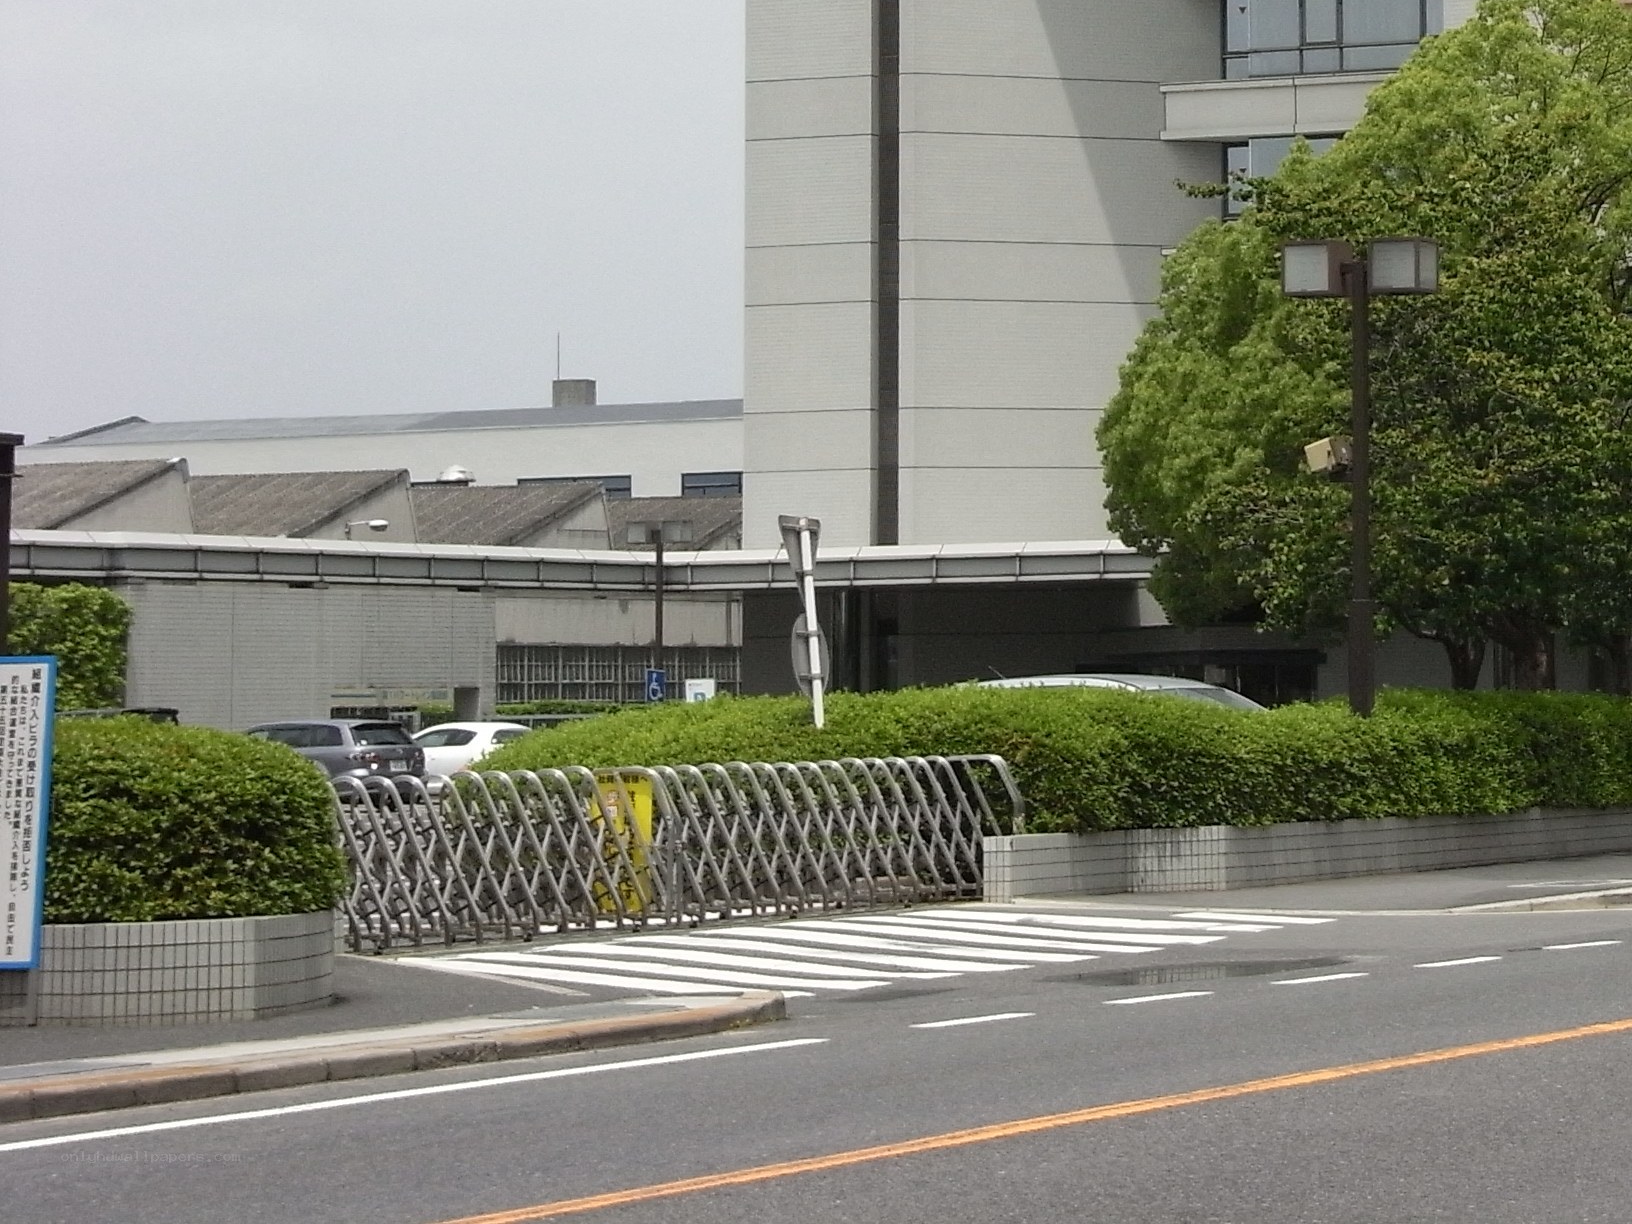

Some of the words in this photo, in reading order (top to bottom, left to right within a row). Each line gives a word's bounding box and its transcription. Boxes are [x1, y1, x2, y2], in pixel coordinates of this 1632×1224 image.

[20, 668, 42, 891] 組織介入ビラの受け取りを拒否しよう
